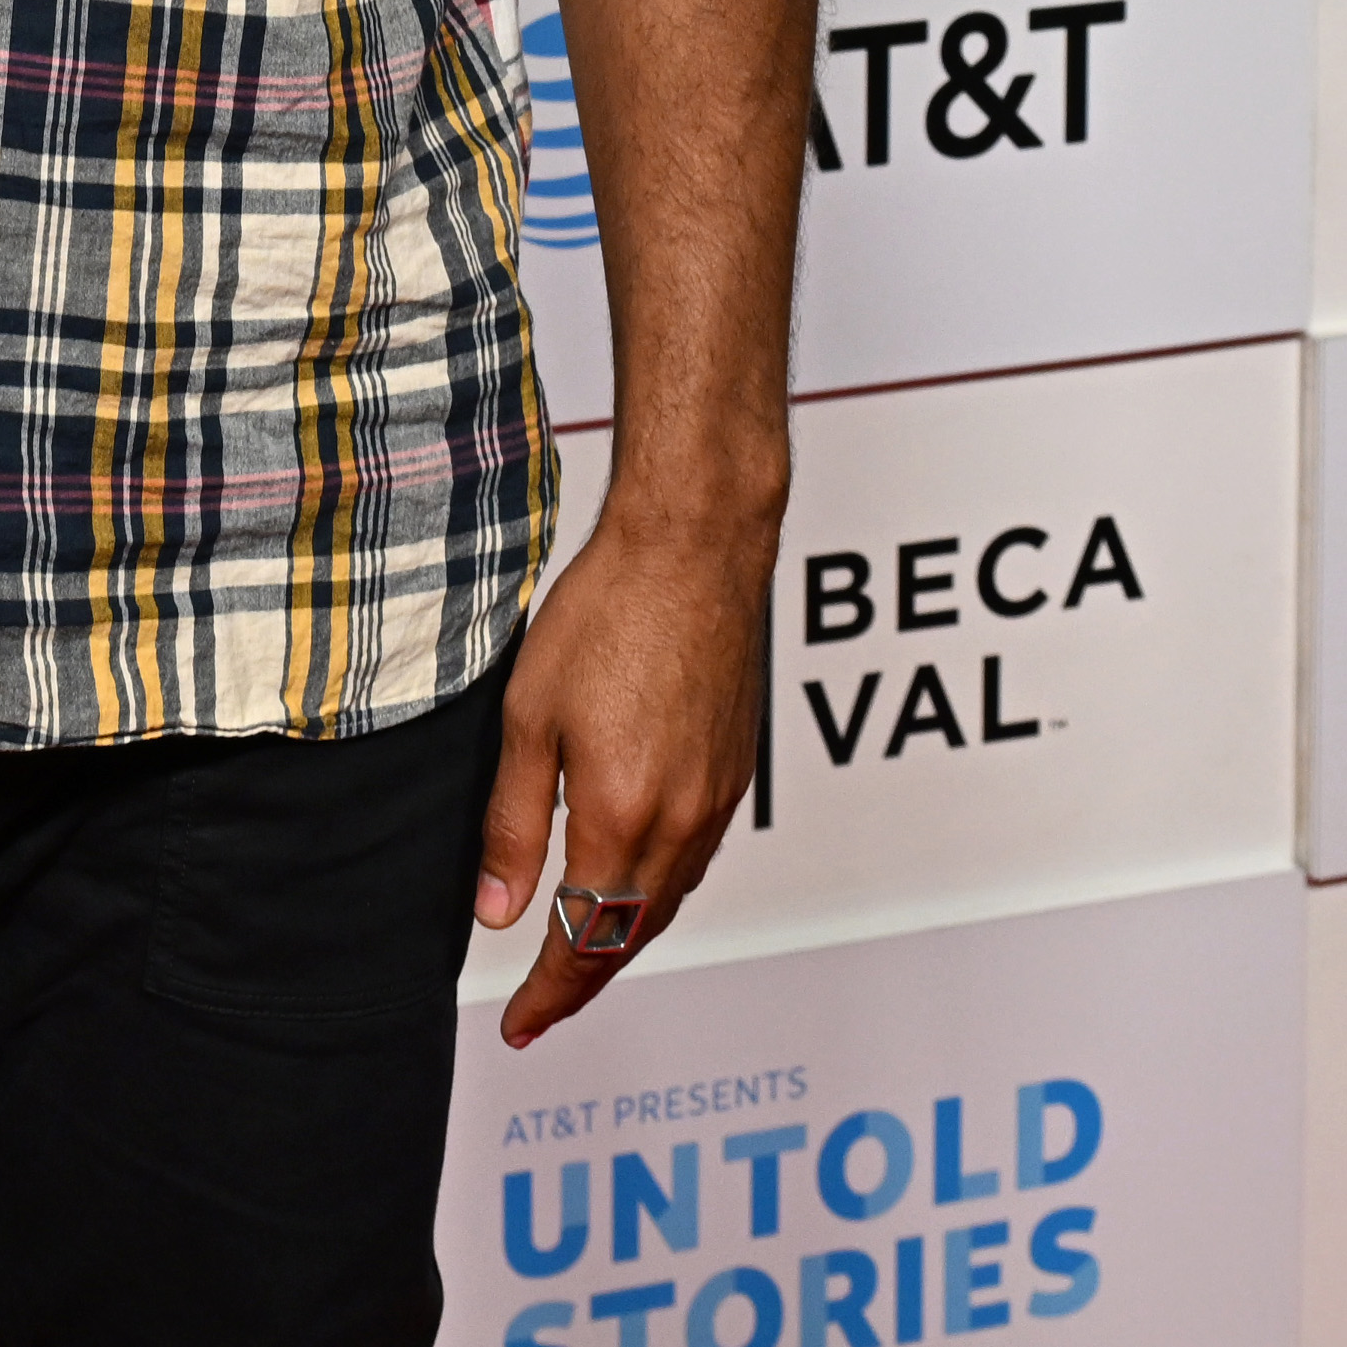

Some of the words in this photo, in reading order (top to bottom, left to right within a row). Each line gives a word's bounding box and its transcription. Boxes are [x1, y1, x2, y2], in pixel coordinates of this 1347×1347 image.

[810, 0, 1127, 173] T&T
[803, 515, 1144, 647] BECA
[503, 1098, 599, 1147] AT&T
[613, 1065, 809, 1127] PRESENTS
[503, 1077, 1104, 1279] UNTOLD
